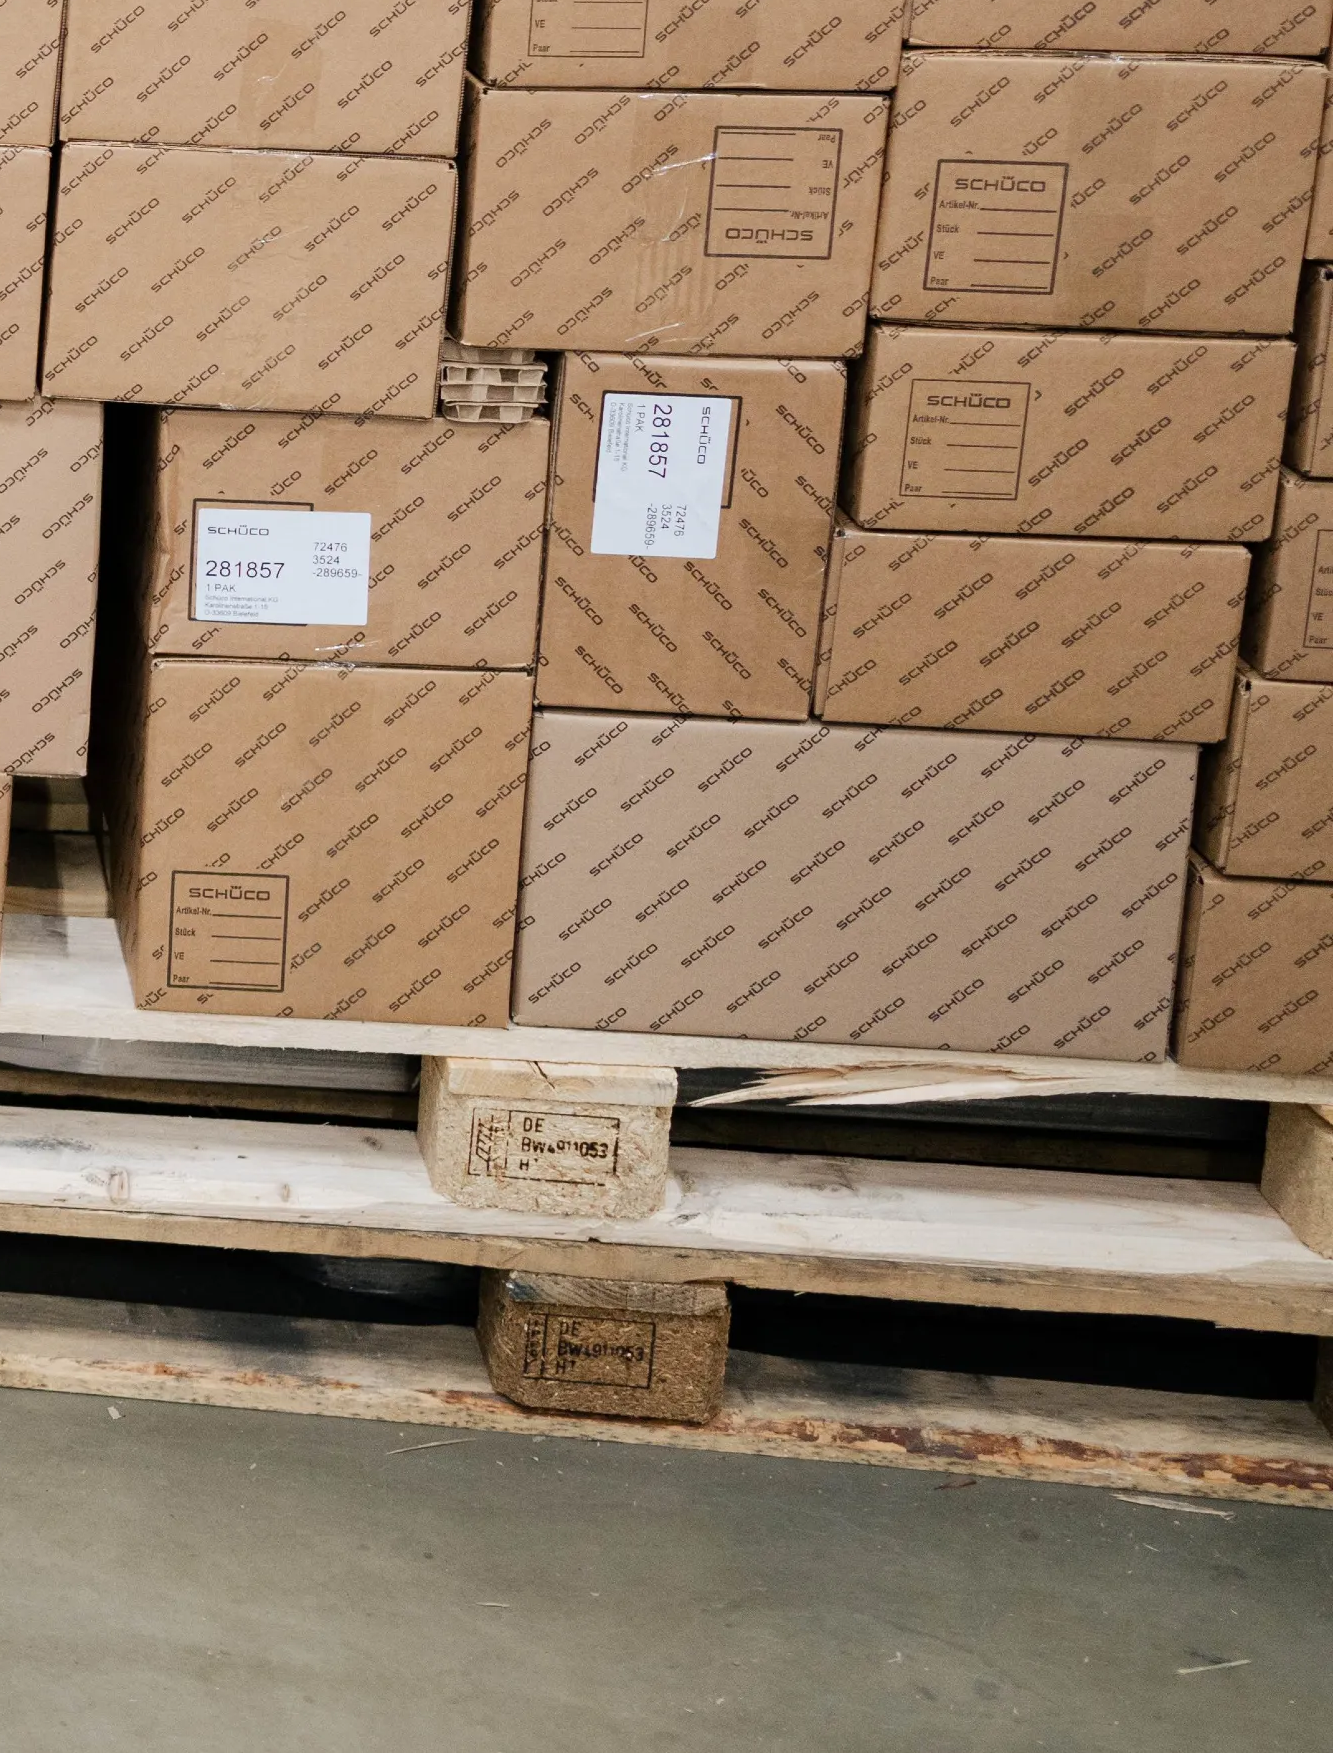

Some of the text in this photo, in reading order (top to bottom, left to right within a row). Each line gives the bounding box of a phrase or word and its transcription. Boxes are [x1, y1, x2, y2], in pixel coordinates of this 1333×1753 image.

[91, 6, 144, 53] SCHÜCO
[535, 19, 545, 28] VE
[533, 44, 550, 52] Paar
[784, 17, 842, 67] SCHÜCO
[950, 77, 1010, 127] SCHÜCO
[496, 119, 551, 167] SCHÜCO
[817, 134, 836, 143] Paar
[822, 159, 834, 169] VE
[808, 186, 831, 195] Stück
[955, 176, 1046, 192] SCHÜCO
[382, 184, 437, 231] SCHÜCO
[939, 200, 980, 210] Artikel-Nr.
[789, 210, 830, 220] Artikel-Nr.
[725, 228, 813, 244] SCHÜCO
[936, 224, 959, 233] Stück
[933, 251, 945, 260] VE
[930, 277, 949, 286] Paar
[1224, 256, 1286, 305] SCHÜCO
[557, 287, 613, 335] SCHÜCO
[762, 291, 819, 339] SCHÜCO
[318, 324, 372, 370] SCHÜCO
[1147, 346, 1208, 395] SCHÜCO
[927, 393, 1011, 408] SCHÜCO
[634, 411, 646, 433] PAK
[912, 414, 949, 424] Artikel-Nr.
[697, 406, 711, 465] SCHÜCO
[776, 405, 825, 454] SCHÜCO
[648, 404, 673, 479] 281857
[910, 436, 932, 445] Stück
[324, 450, 378, 495] SCHÜCO
[907, 460, 918, 470] VE
[1028, 439, 1088, 487] SCHÜCO
[904, 483, 922, 492] Paar
[660, 504, 672, 529] 3524
[673, 505, 687, 537] 72476
[207, 525, 270, 536] SCHÜCO
[314, 542, 348, 552] 72476
[206, 560, 285, 579] 281857
[313, 555, 340, 565] 3524
[214, 584, 236, 592] PAK
[1316, 588, 1333, 596] Stüc
[555, 577, 603, 625] SCHÜCO
[1144, 582, 1205, 628] SCHÜCO
[464, 591, 517, 636] SCHÜCO
[853, 594, 912, 638] SCHÜCO
[189, 677, 240, 722] SCHÜCO
[1255, 745, 1317, 790] SCHÜCO
[1109, 759, 1166, 805] SCHÜCO
[544, 788, 597, 830] SCHÜCO
[447, 839, 499, 883] SCHÜCO
[189, 886, 270, 901] SCHÜCO
[176, 906, 212, 916] Artikel-Nr.
[175, 927, 196, 936] Stück
[174, 952, 184, 960] VE
[173, 974, 190, 983] Paar
[389, 969, 441, 1012] SCHÜCO
[928, 979, 984, 1022] SCHÜCO
[523, 1117, 545, 1132] DE
[559, 1320, 582, 1336] DE
